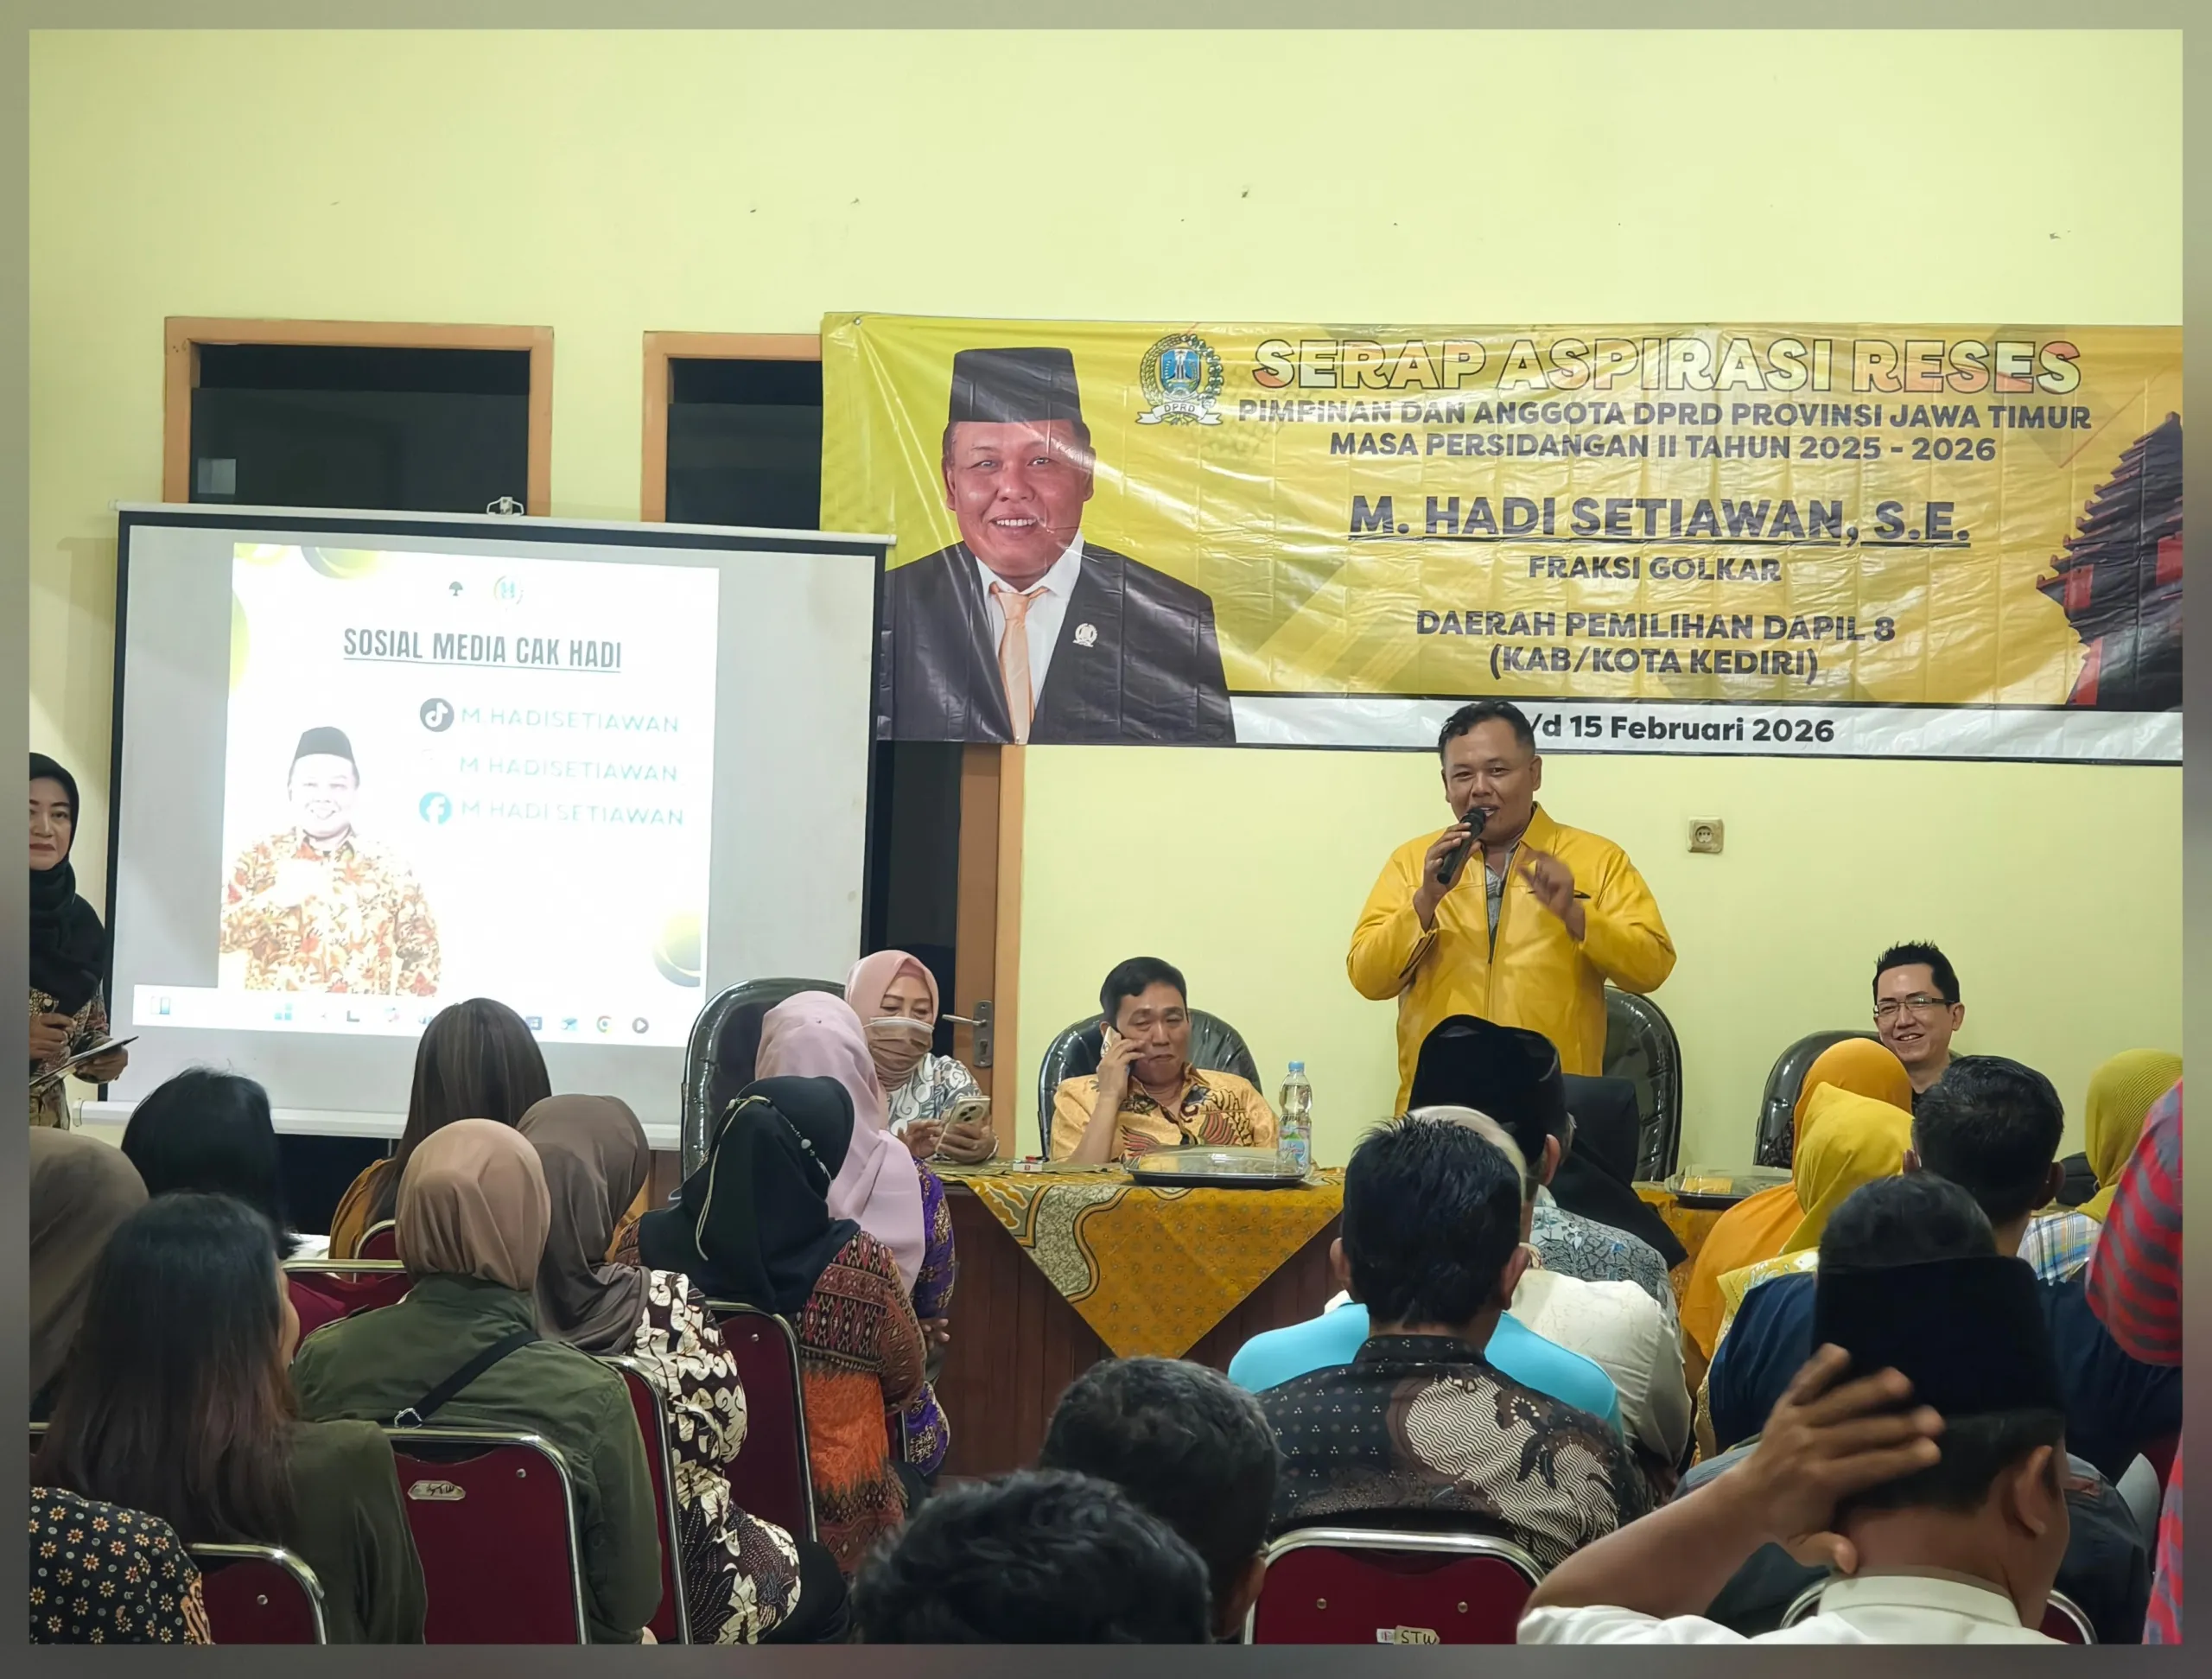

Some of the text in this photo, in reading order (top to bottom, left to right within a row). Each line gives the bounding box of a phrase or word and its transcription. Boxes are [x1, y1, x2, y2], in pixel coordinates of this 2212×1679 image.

[1251, 337, 2082, 394] SERAP ASPIRASI RESES
[1164, 404, 1195, 413] DPRD
[1238, 398, 2092, 429] PIMPINAN DAN ANGGOTA DPRD PROVINSI JAWA TIMUR
[1330, 432, 1419, 456] MASA
[1427, 432, 1648, 458] PERSIDANGAN
[1657, 436, 1676, 458] II
[1686, 436, 1791, 459] TAHUN
[1799, 436, 1881, 460] 2025
[1910, 437, 1996, 461] 2026
[1350, 495, 1971, 547] M. HADI SETIAWAN, S.E.
[1529, 556, 1782, 582] FRAKSI GOLKAR
[1417, 610, 1896, 643] DAERAH PEMILIHAN DAPIL 8
[344, 627, 621, 668] SOSIAL MEDIA CAK HADI
[1489, 644, 1819, 685] (KAB/KOTA KEDIRI)
[1530, 713, 1834, 742] /d 15 Februari 2026
